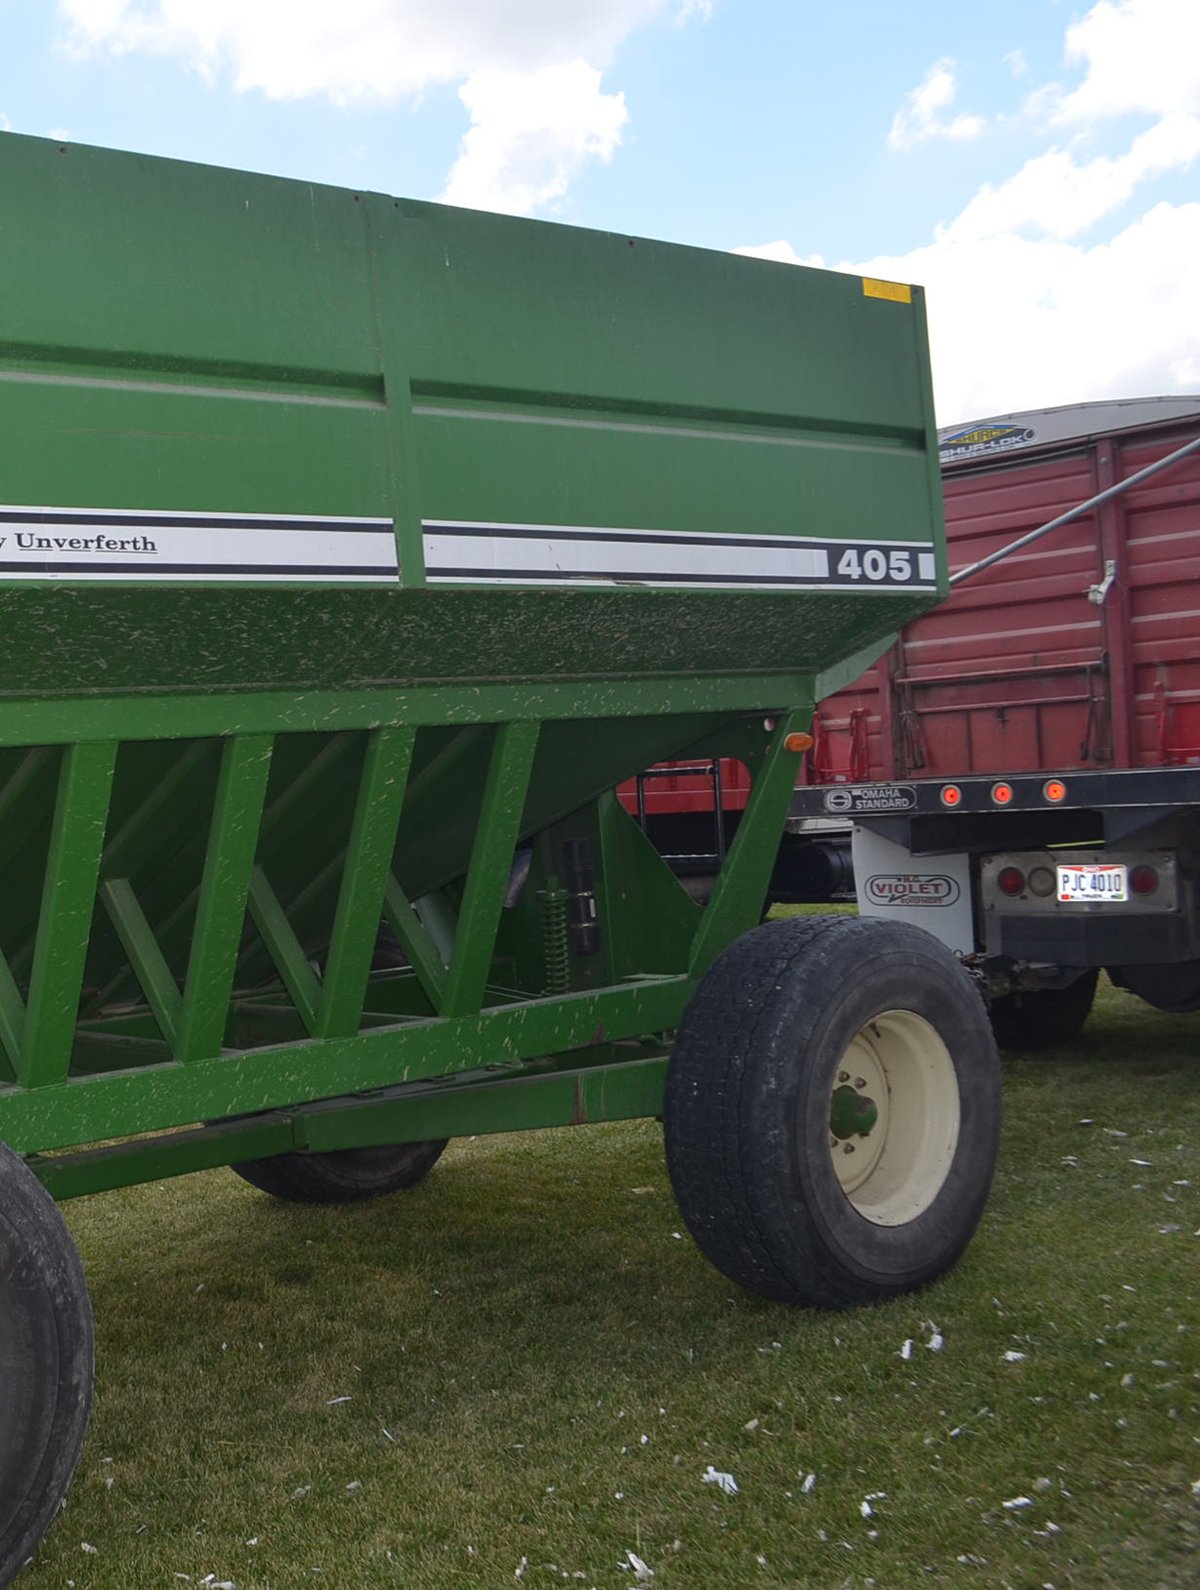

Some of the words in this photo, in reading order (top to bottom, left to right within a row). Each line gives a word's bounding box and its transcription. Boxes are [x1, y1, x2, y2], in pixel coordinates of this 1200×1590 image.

[14, 533, 158, 554] Unverferth
[837, 549, 912, 581] 405
[862, 788, 901, 799] OMAHA
[855, 798, 910, 809] STANDARD
[875, 883, 943, 894] VIOLET
[1062, 874, 1087, 892] PJC
[1090, 874, 1122, 892] 4010
